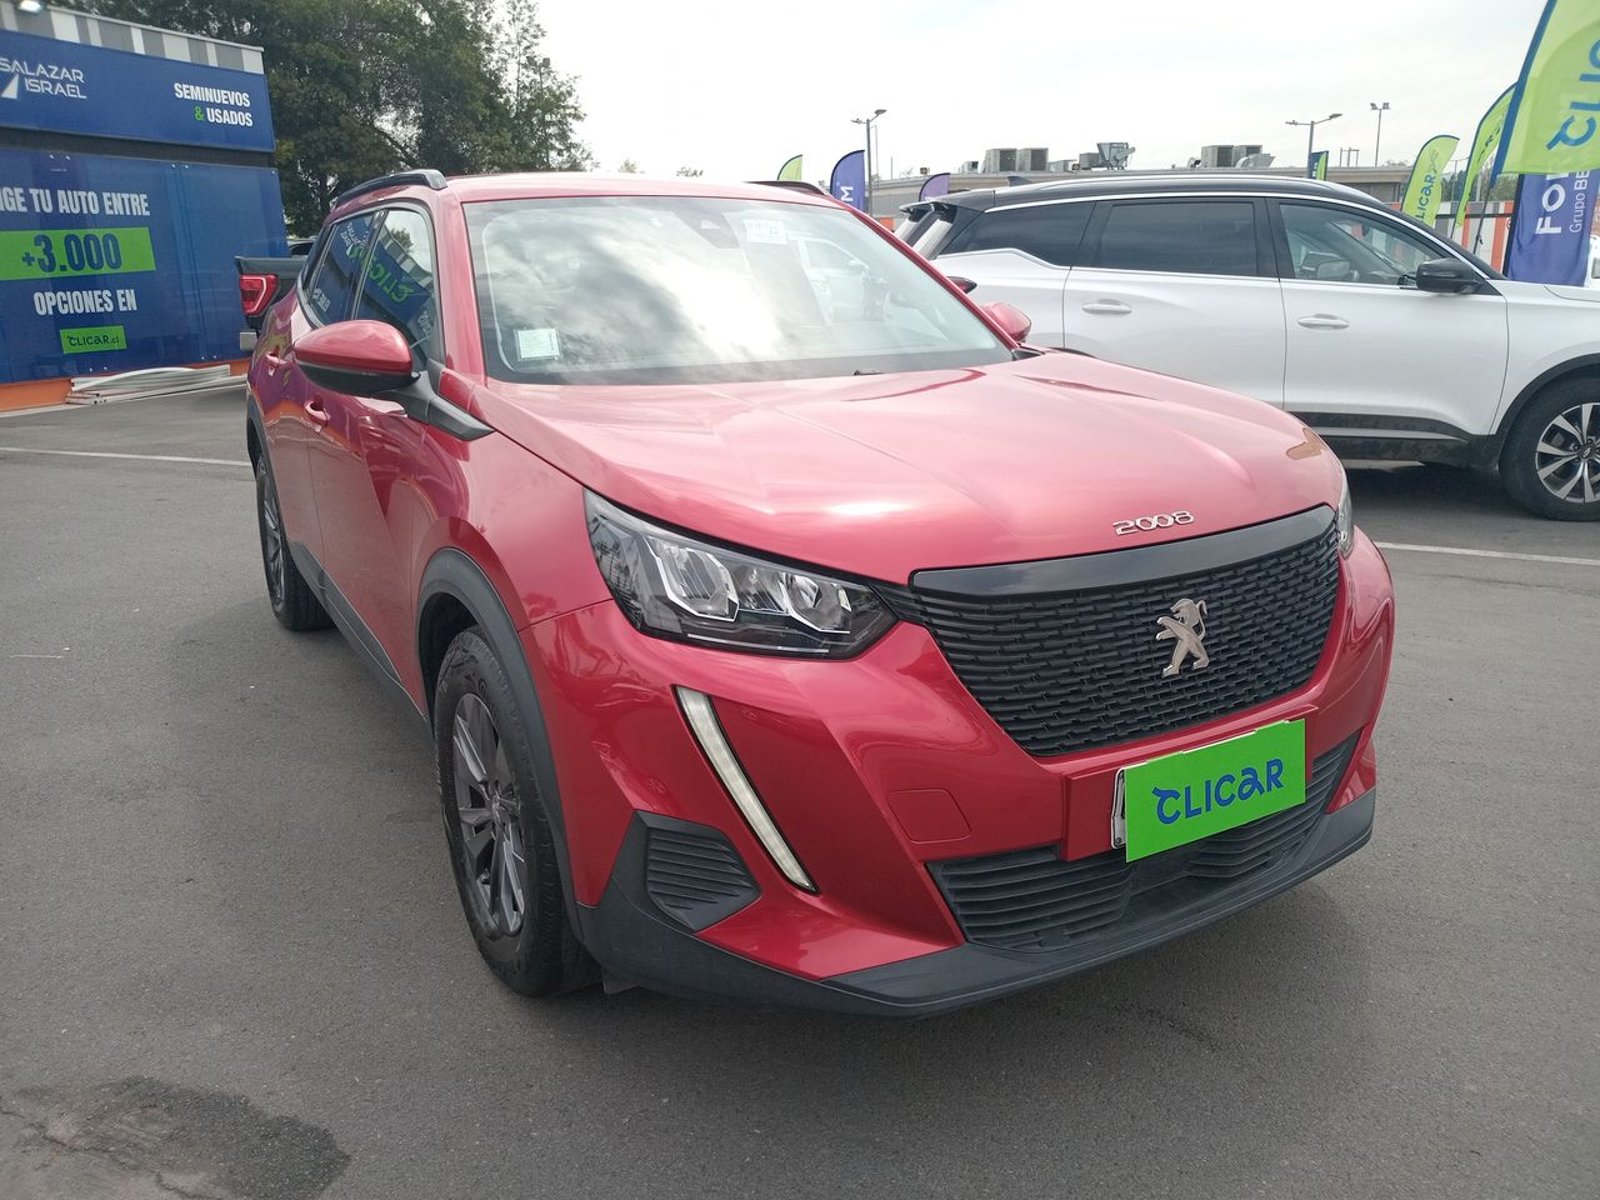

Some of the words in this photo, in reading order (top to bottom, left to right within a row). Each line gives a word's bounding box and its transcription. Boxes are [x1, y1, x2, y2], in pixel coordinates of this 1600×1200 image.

[0, 57, 84, 84] SALAZAR
[25, 78, 88, 99] ISRAEL
[174, 82, 251, 107] SEMINUEVOS
[194, 106, 205, 121] &
[206, 107, 253, 127] USADOS
[29, 188, 53, 214] TU
[57, 189, 100, 215] AUTO
[102, 192, 150, 216] ENTRE
[1535, 173, 1569, 234] FO
[1570, 193, 1586, 233] Grupo
[22, 233, 122, 272] +3.000
[33, 289, 114, 316] OPCIONES
[116, 288, 138, 311] EN
[1112, 510, 1194, 536] 2008
